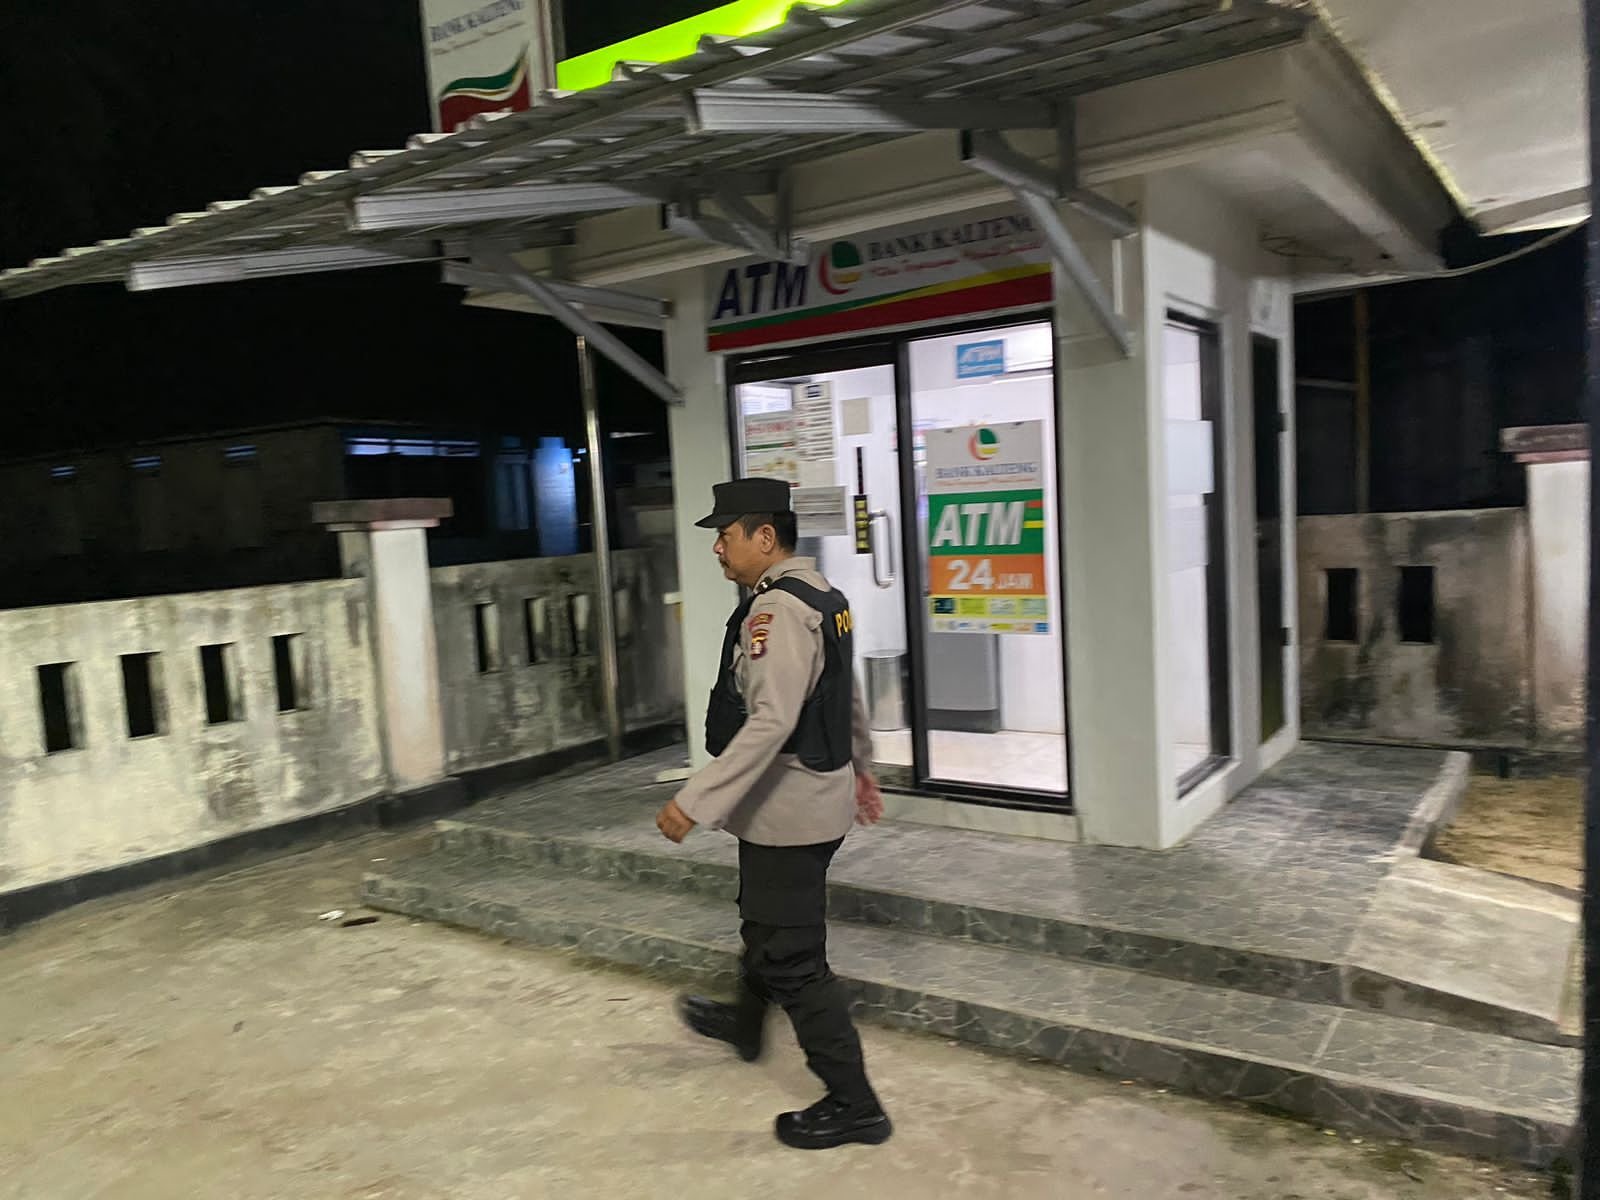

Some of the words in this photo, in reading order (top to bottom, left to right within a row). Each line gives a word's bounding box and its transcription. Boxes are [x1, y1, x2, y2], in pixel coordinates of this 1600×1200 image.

[867, 232, 926, 261] BANK
[712, 261, 809, 320] ATM
[930, 501, 1025, 547] ATM
[947, 558, 995, 590] 24
